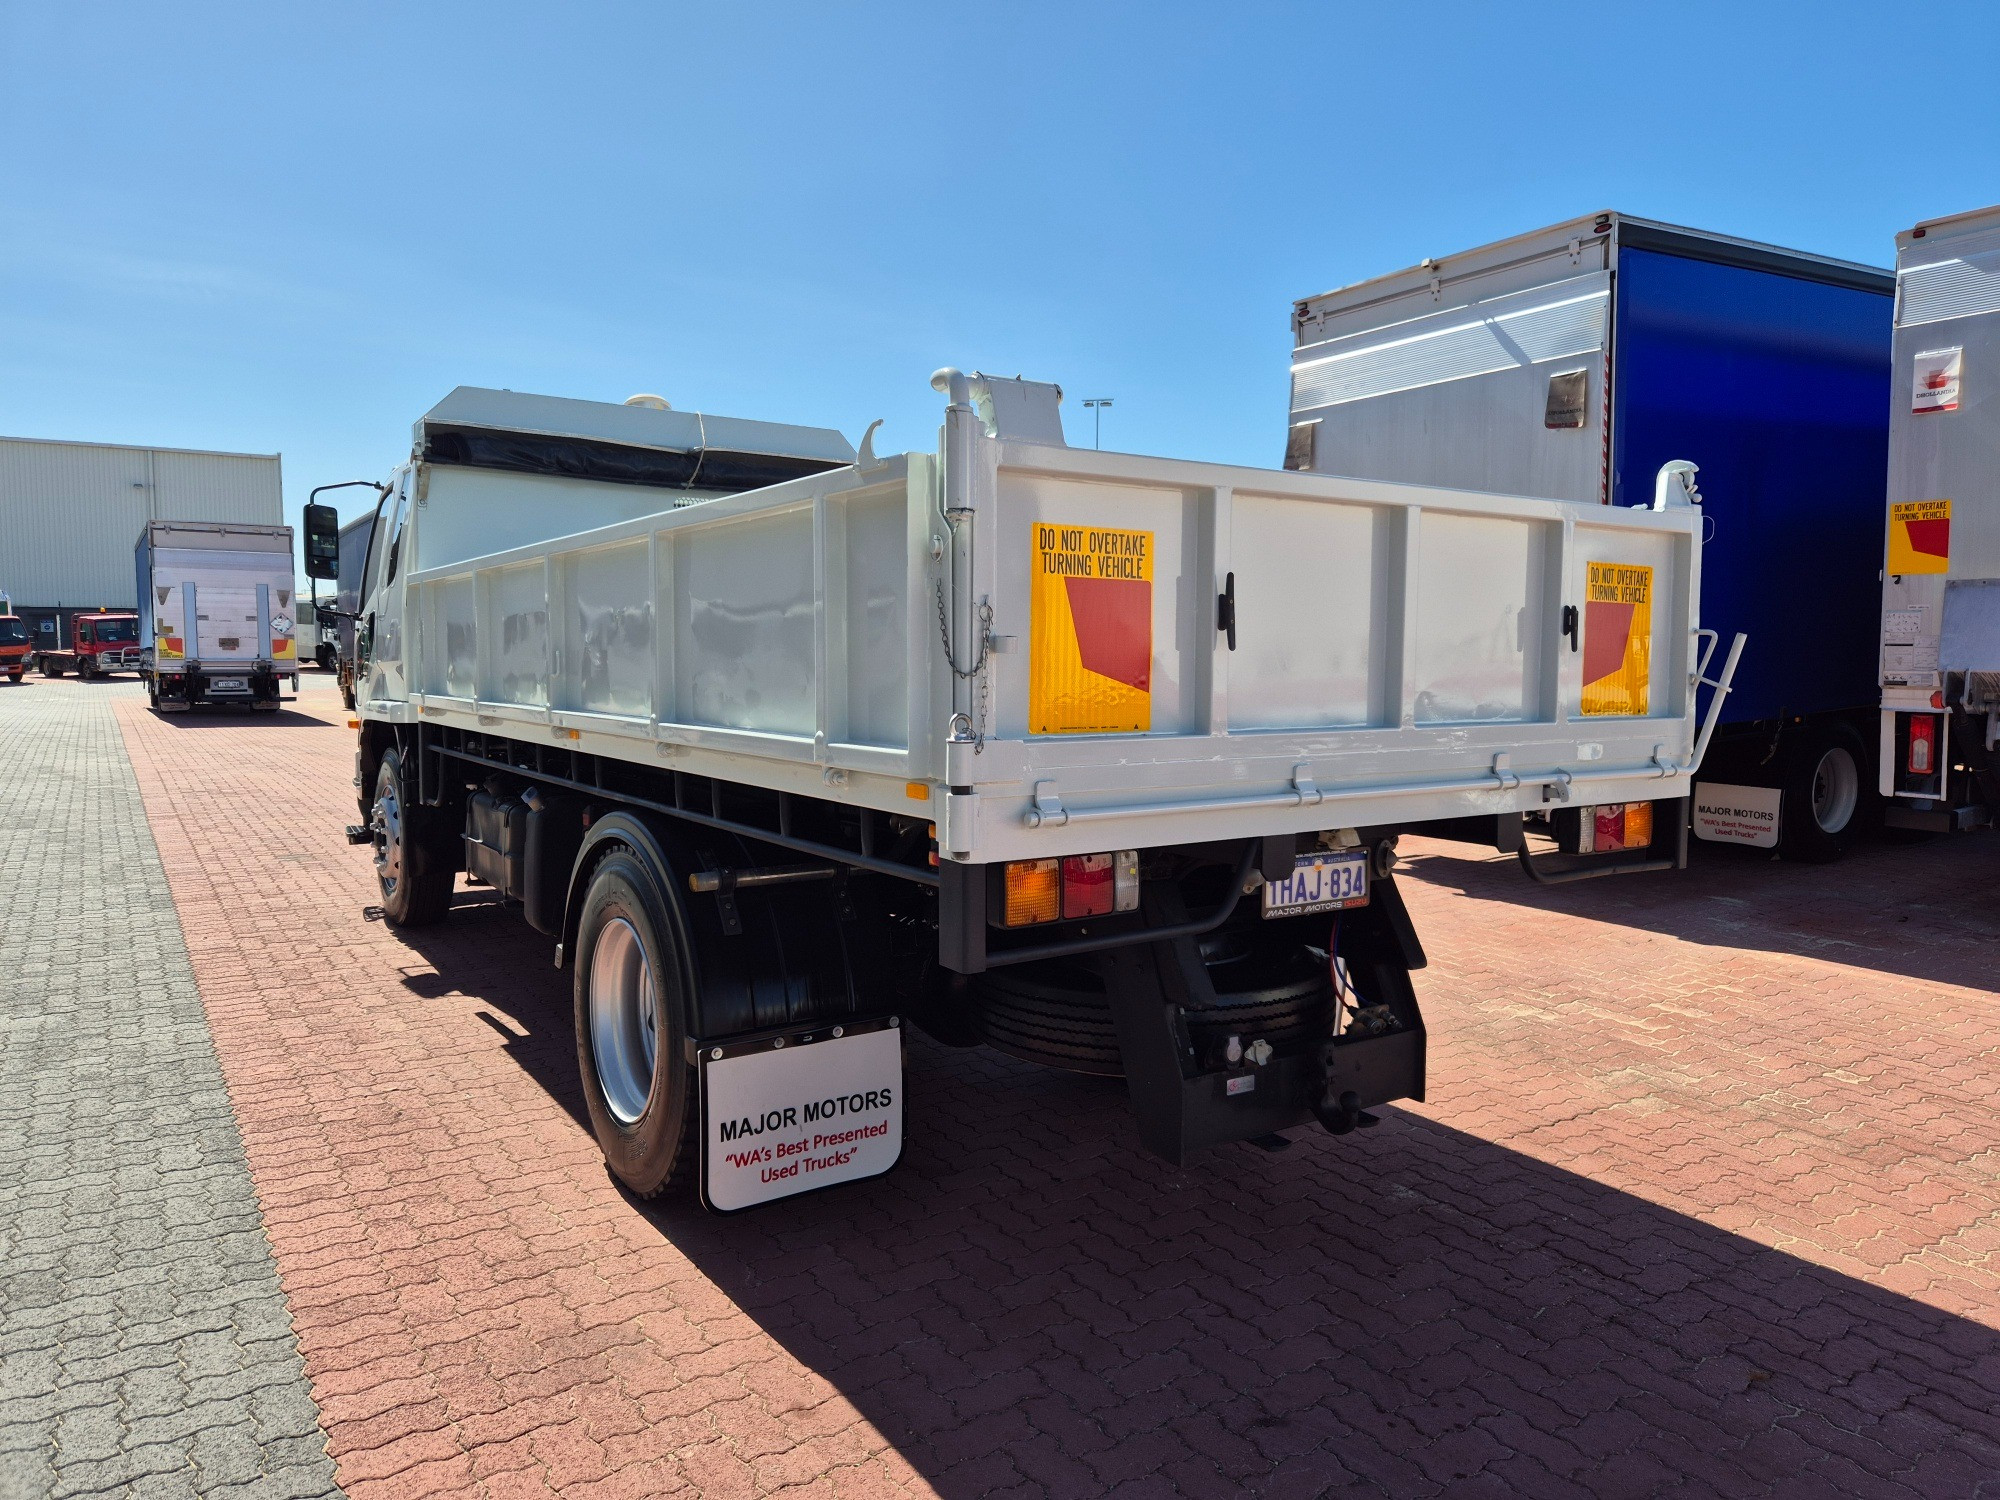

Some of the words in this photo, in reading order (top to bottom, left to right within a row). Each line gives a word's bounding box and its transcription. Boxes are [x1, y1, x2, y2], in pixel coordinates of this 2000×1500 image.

[1916, 388, 1956, 399] DHOLLANDIA
[1894, 504, 1902, 513] DO
[1904, 503, 1916, 512] NOT
[1917, 501, 1947, 512] OVERTAKE
[1894, 512, 1920, 522] TURNING
[1922, 510, 1947, 520] VEHICLE
[1039, 527, 1055, 551] DO
[1061, 529, 1084, 553] NOT
[1089, 531, 1146, 557] OVERTAKE
[1041, 551, 1092, 576] TURNING
[1097, 555, 1144, 580] VEHICLE
[1590, 567, 1599, 583] DO
[1602, 568, 1614, 584] NOT
[1617, 569, 1648, 587] OVERTAKE
[1591, 585, 1618, 601] TURNING
[1621, 586, 1646, 603] VEHICLE
[1698, 805, 1731, 816] MAJOR
[1733, 808, 1774, 821] MOTORS
[1714, 828, 1733, 836] Used
[1721, 820, 1737, 828] Best
[1738, 822, 1772, 833] Presented
[1265, 906, 1302, 918] MAJOR
[1303, 901, 1343, 913] MOTORS
[1344, 898, 1367, 907] ISUZU
[720, 1107, 798, 1143] MAJOR
[803, 1088, 892, 1124] MOTORS
[776, 1137, 809, 1159] Best
[813, 1119, 888, 1152] Presented
[761, 1160, 799, 1184] Used
